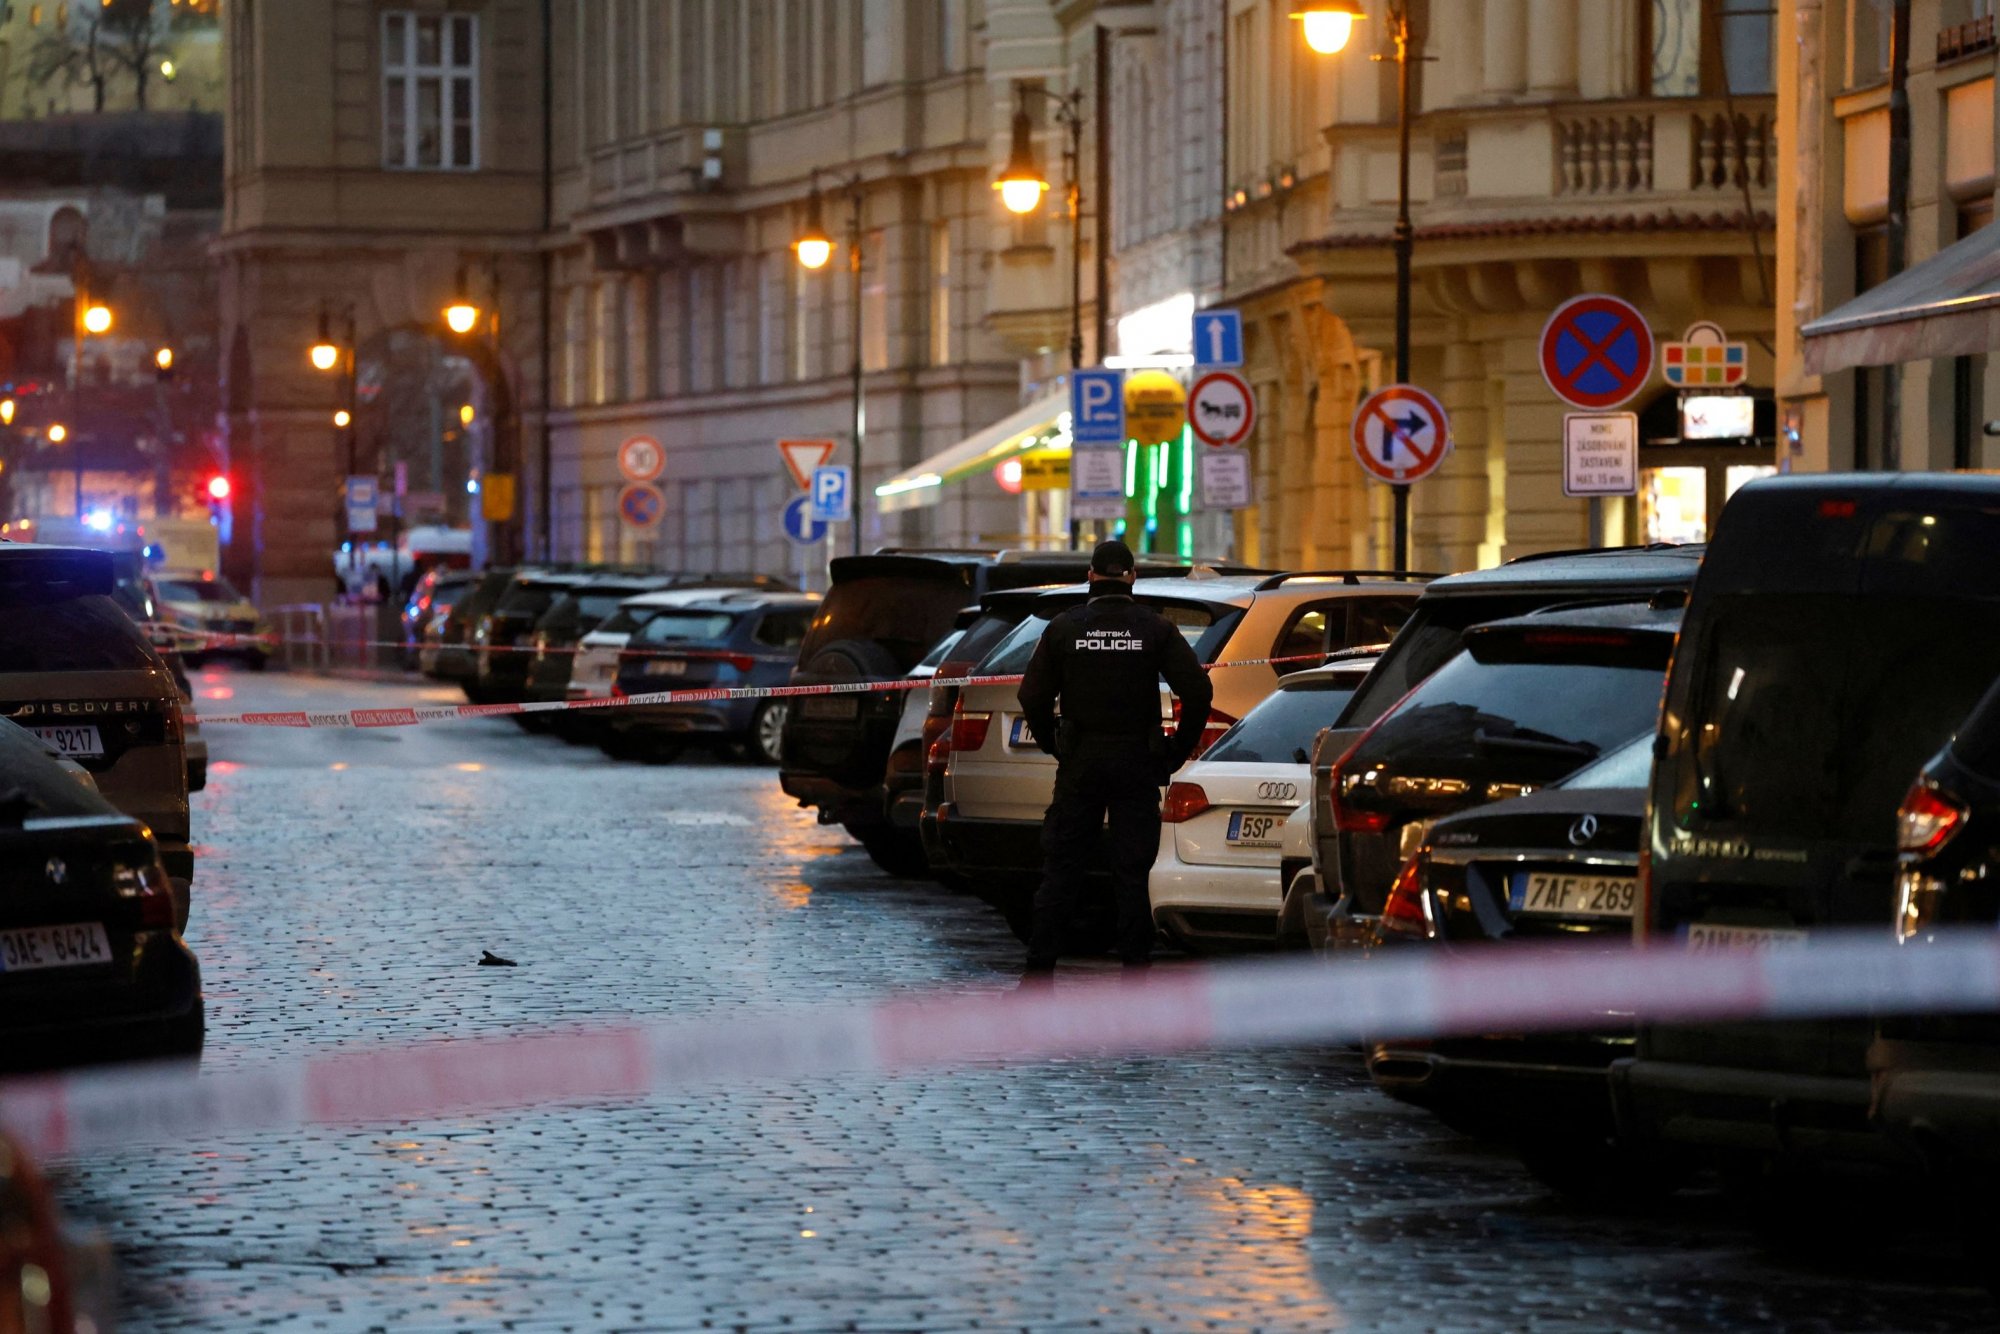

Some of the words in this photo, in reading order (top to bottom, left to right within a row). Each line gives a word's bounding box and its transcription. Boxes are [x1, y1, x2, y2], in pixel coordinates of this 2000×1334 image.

[1082, 379, 1112, 421] P
[819, 473, 841, 502] P
[1086, 629, 1131, 638] MĚSTSKÁ
[1075, 639, 1143, 650] POLICIE
[24, 702, 150, 714] DISCOVERY
[56, 729, 92, 751] 9217
[1242, 817, 1273, 838] 5SP
[1529, 877, 1577, 908] 7AF
